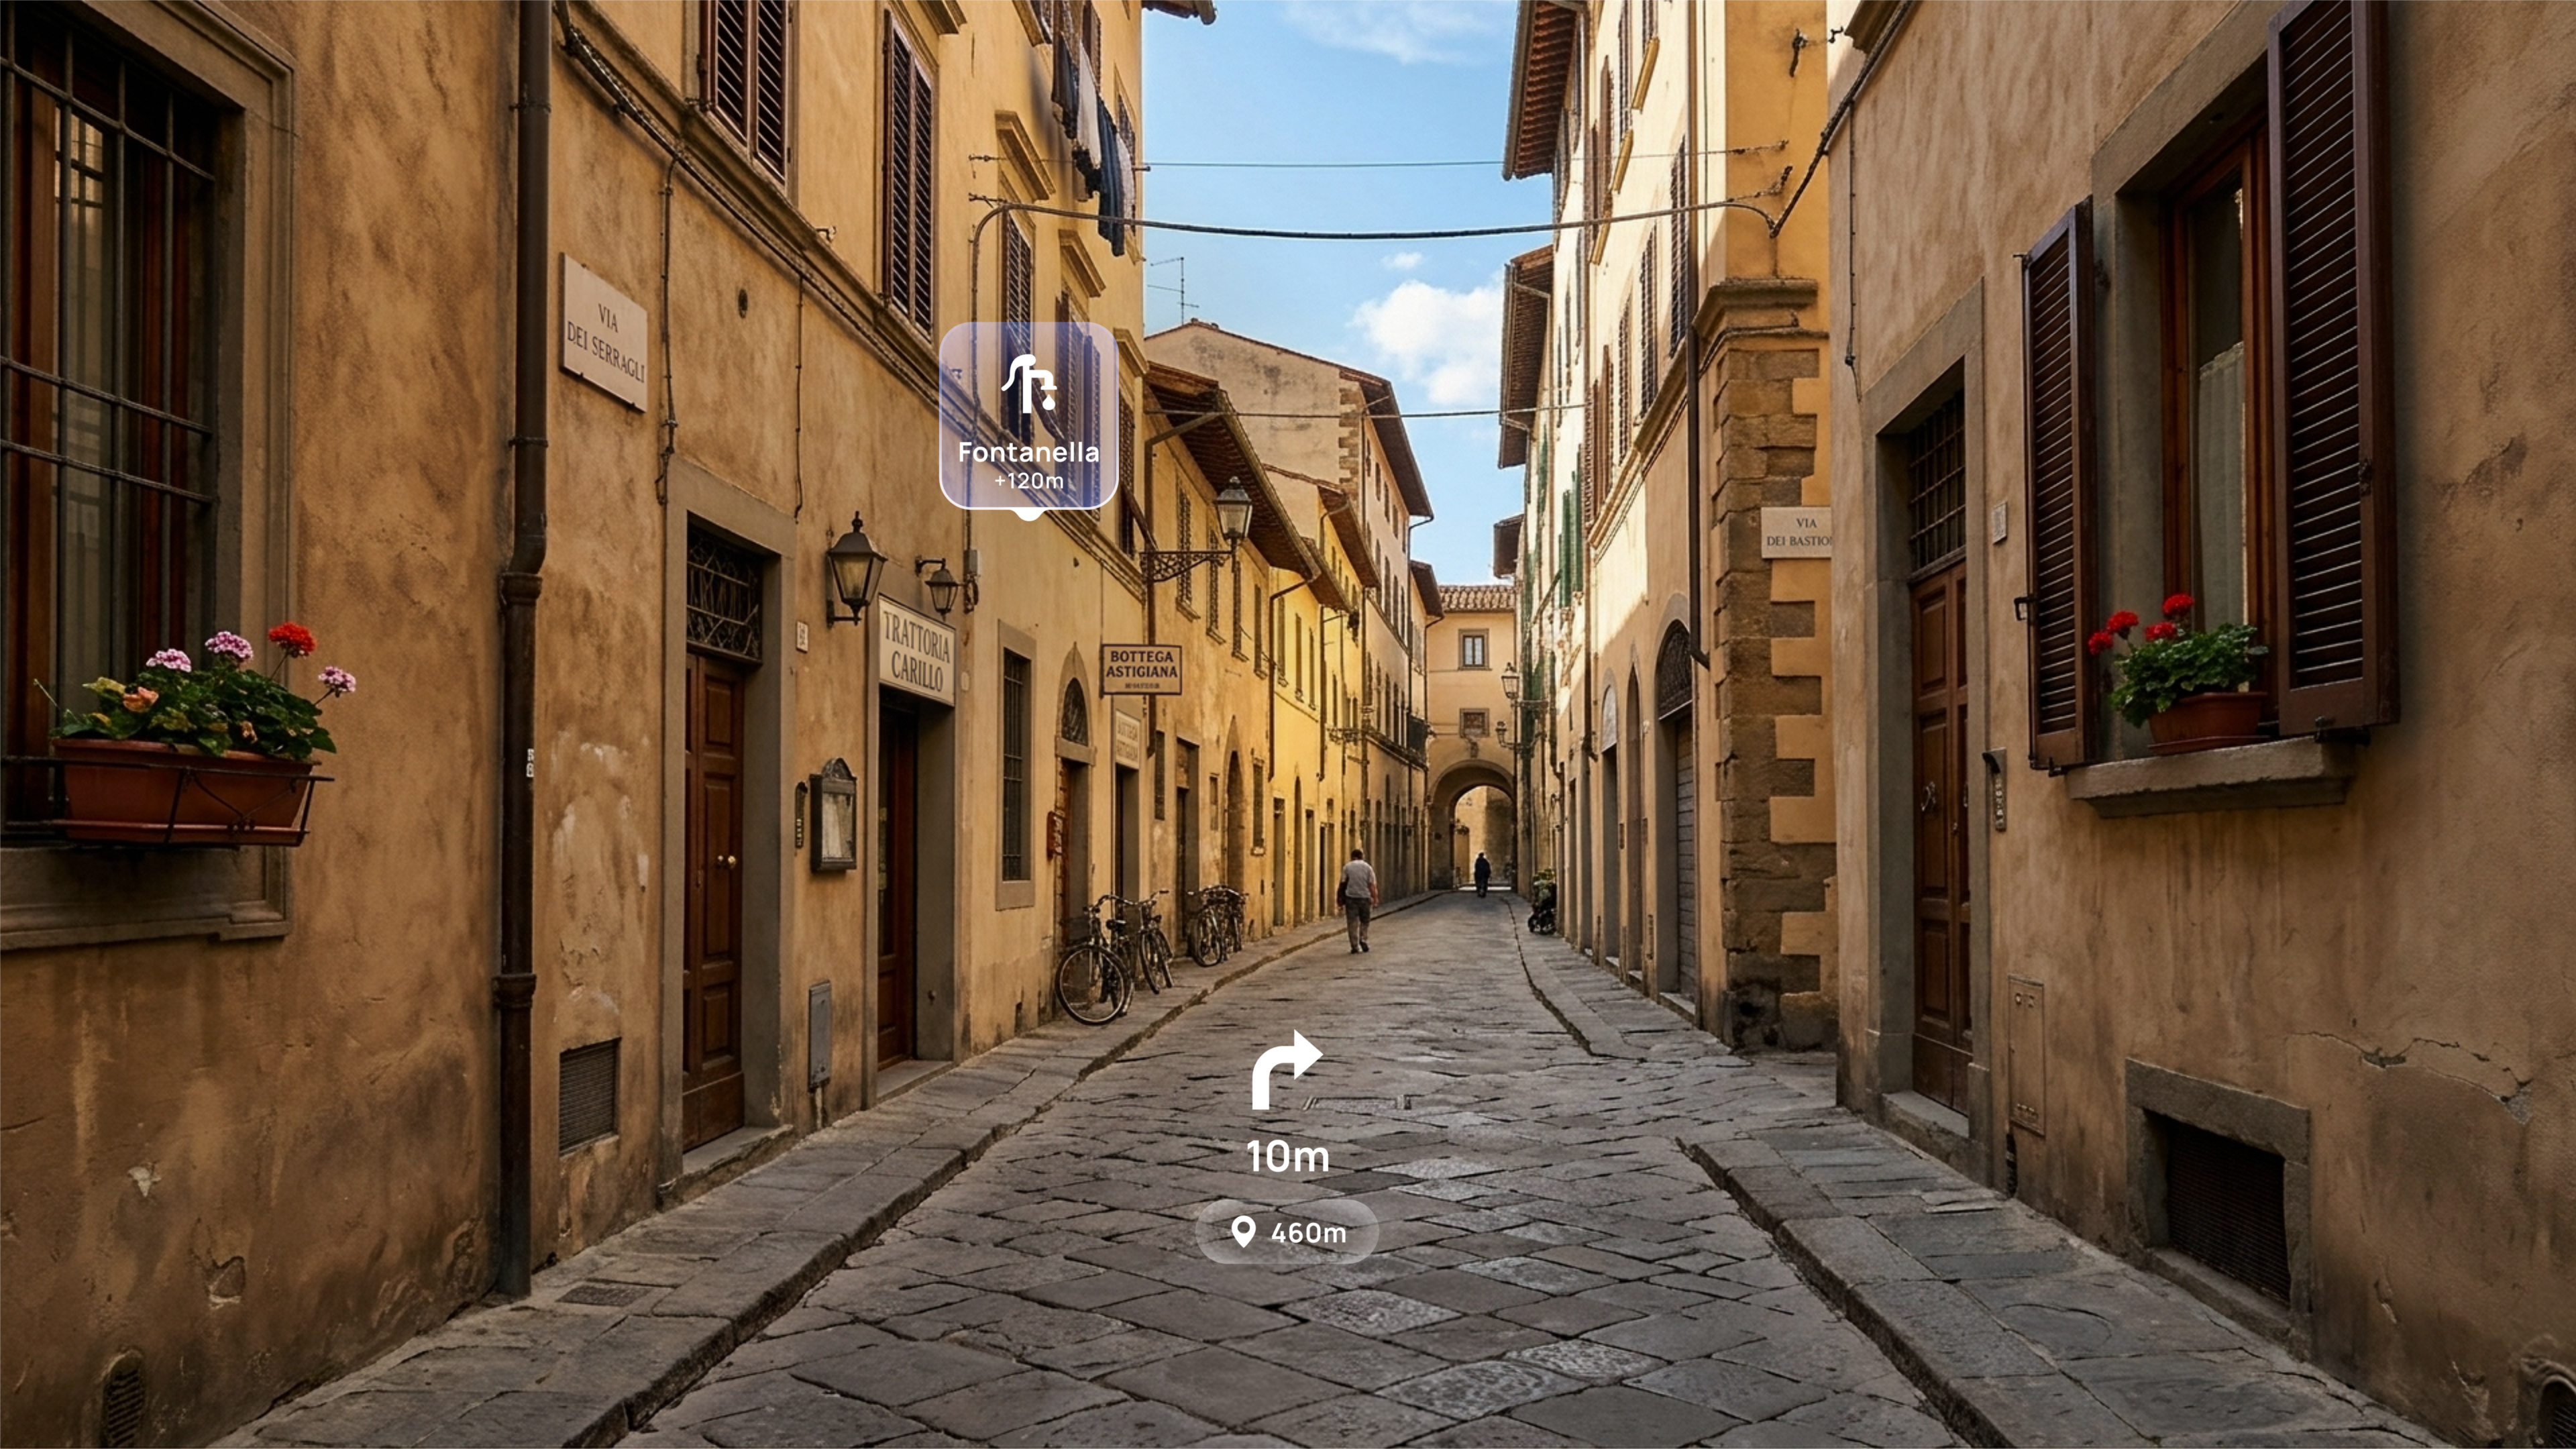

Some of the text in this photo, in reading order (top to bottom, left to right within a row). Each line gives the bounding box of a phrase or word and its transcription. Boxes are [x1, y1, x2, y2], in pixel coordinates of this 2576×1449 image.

[598, 303, 619, 333] VIA
[567, 321, 645, 384] DEI SERRAGLI
[1796, 518, 1817, 528] VIA
[1767, 536, 1786, 546] DEI
[883, 610, 951, 663] TRATTORIA
[1110, 651, 1173, 663] BOTTEGA
[892, 650, 944, 692] CARILLO
[1106, 665, 1178, 678] ASTIGIANA
